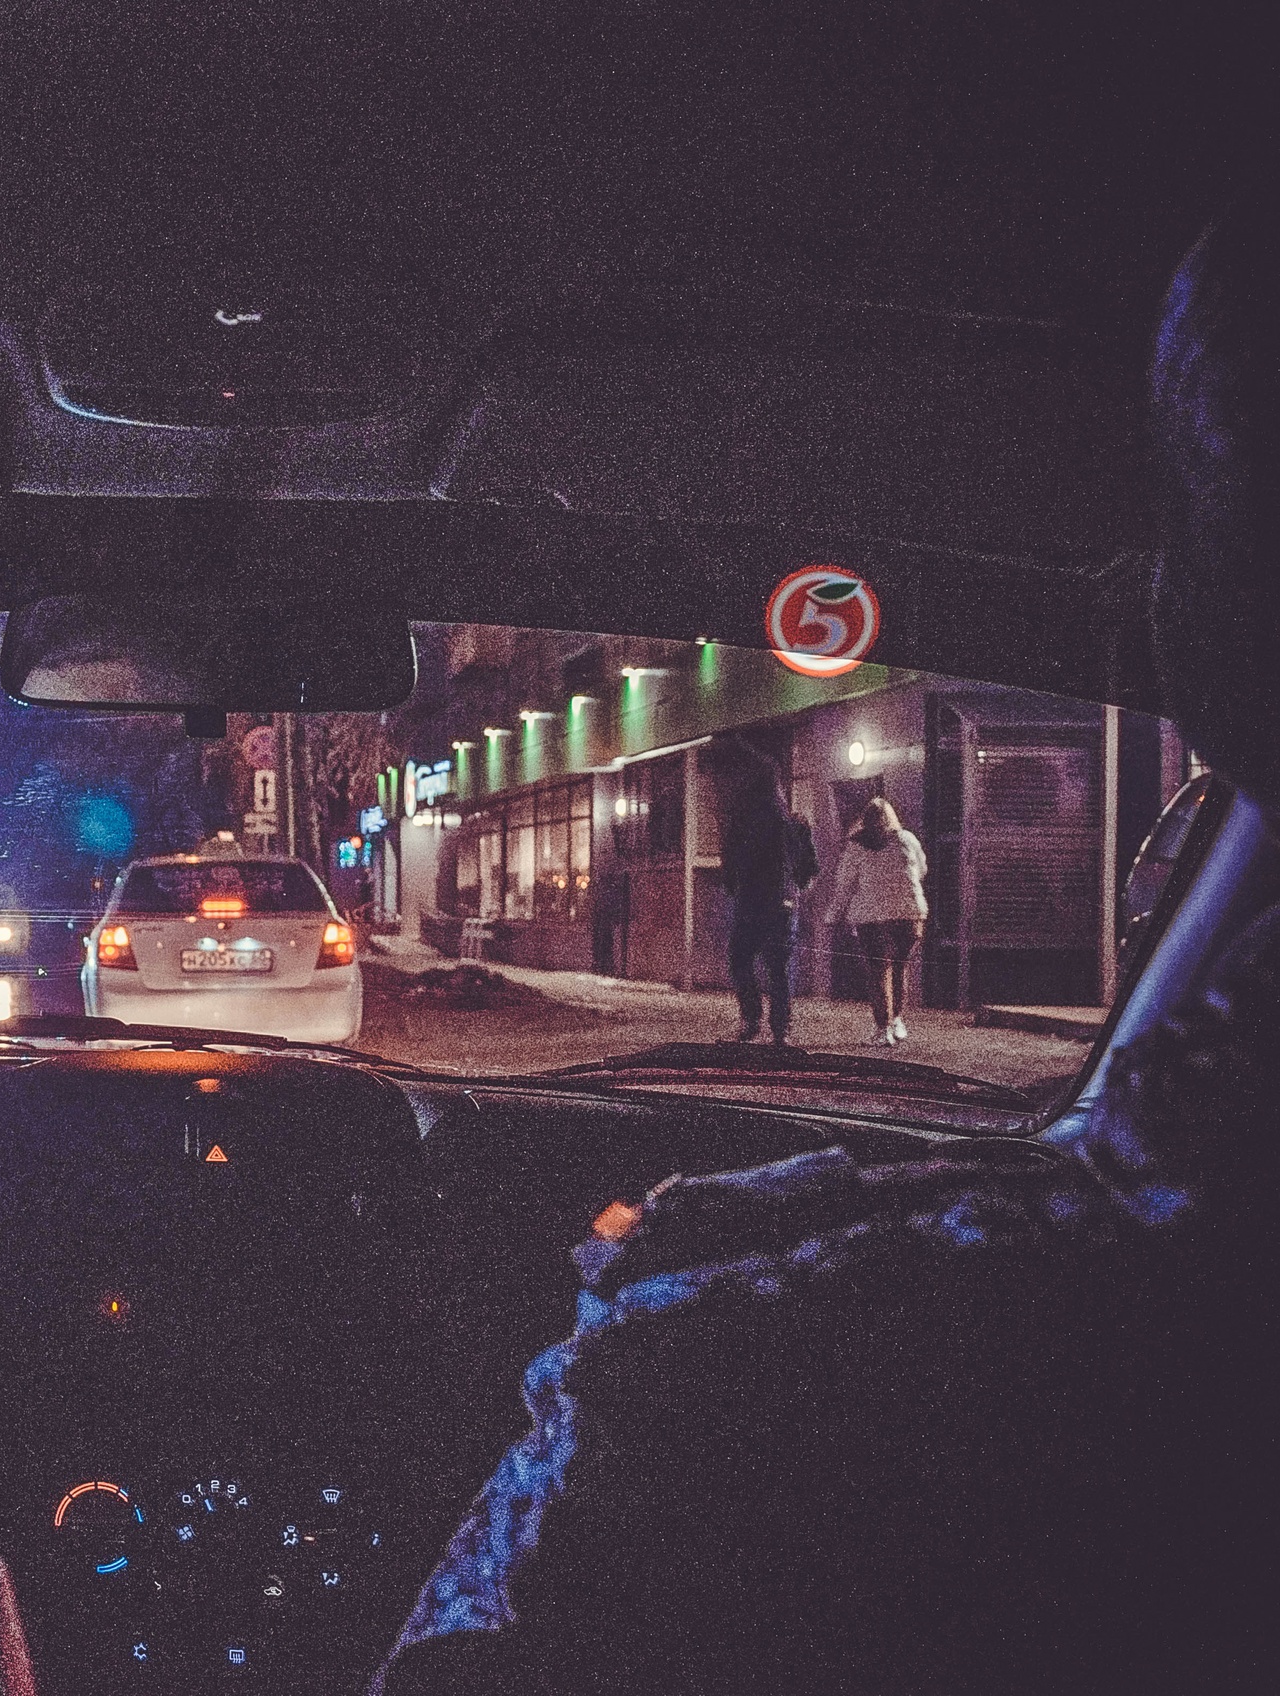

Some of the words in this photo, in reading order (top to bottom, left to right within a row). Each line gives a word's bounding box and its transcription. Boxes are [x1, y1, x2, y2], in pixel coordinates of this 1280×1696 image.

[791, 592, 850, 659] 5
[227, 1484, 236, 1494] 3
[238, 1497, 247, 1506] 4
